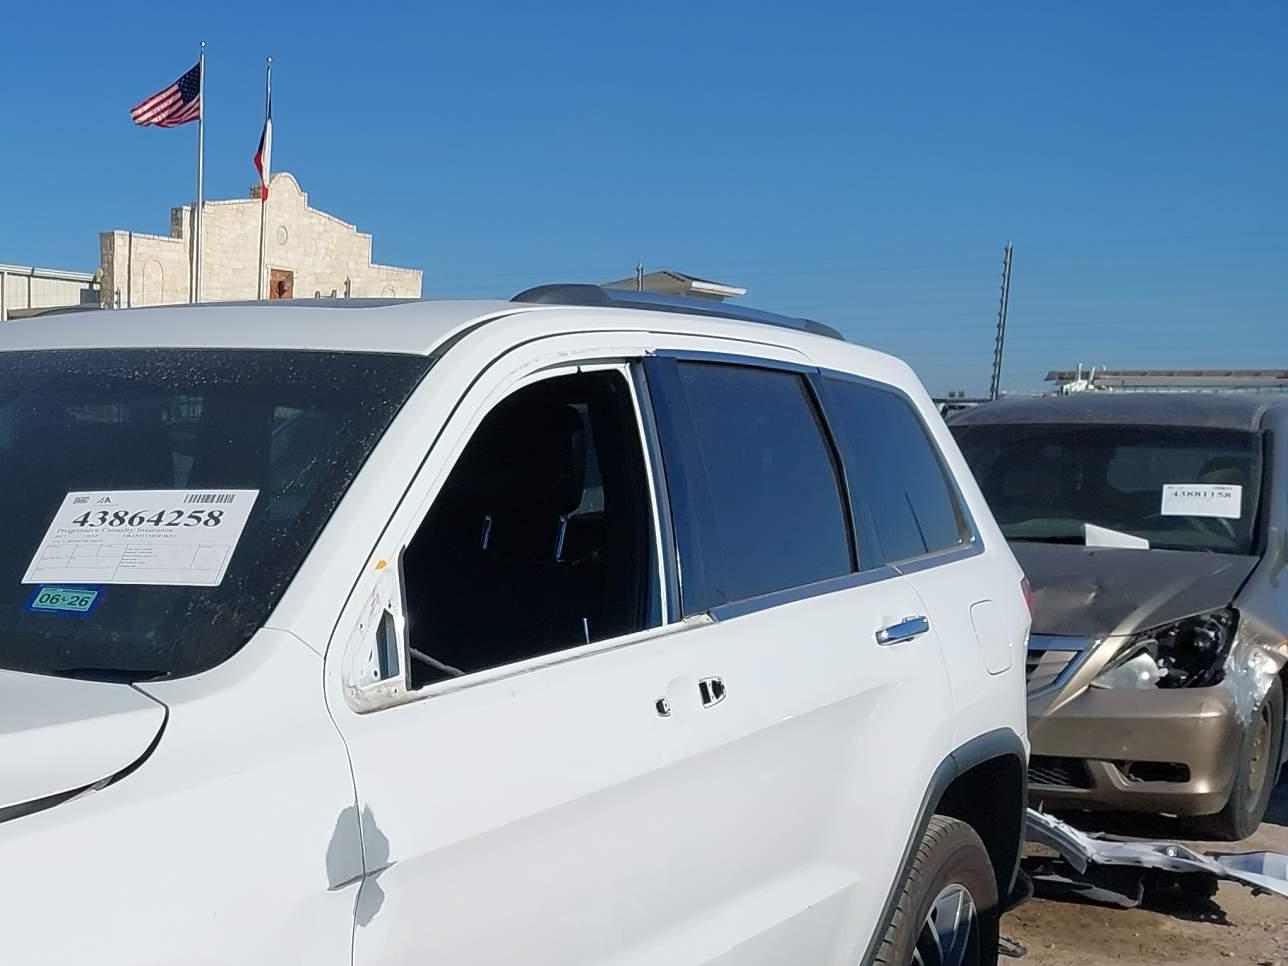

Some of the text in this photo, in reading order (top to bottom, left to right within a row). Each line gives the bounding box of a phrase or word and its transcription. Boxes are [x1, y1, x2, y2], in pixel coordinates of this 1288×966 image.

[72, 509, 224, 527] 43864258
[56, 527, 99, 535] Progressive
[101, 527, 133, 535] Casualty
